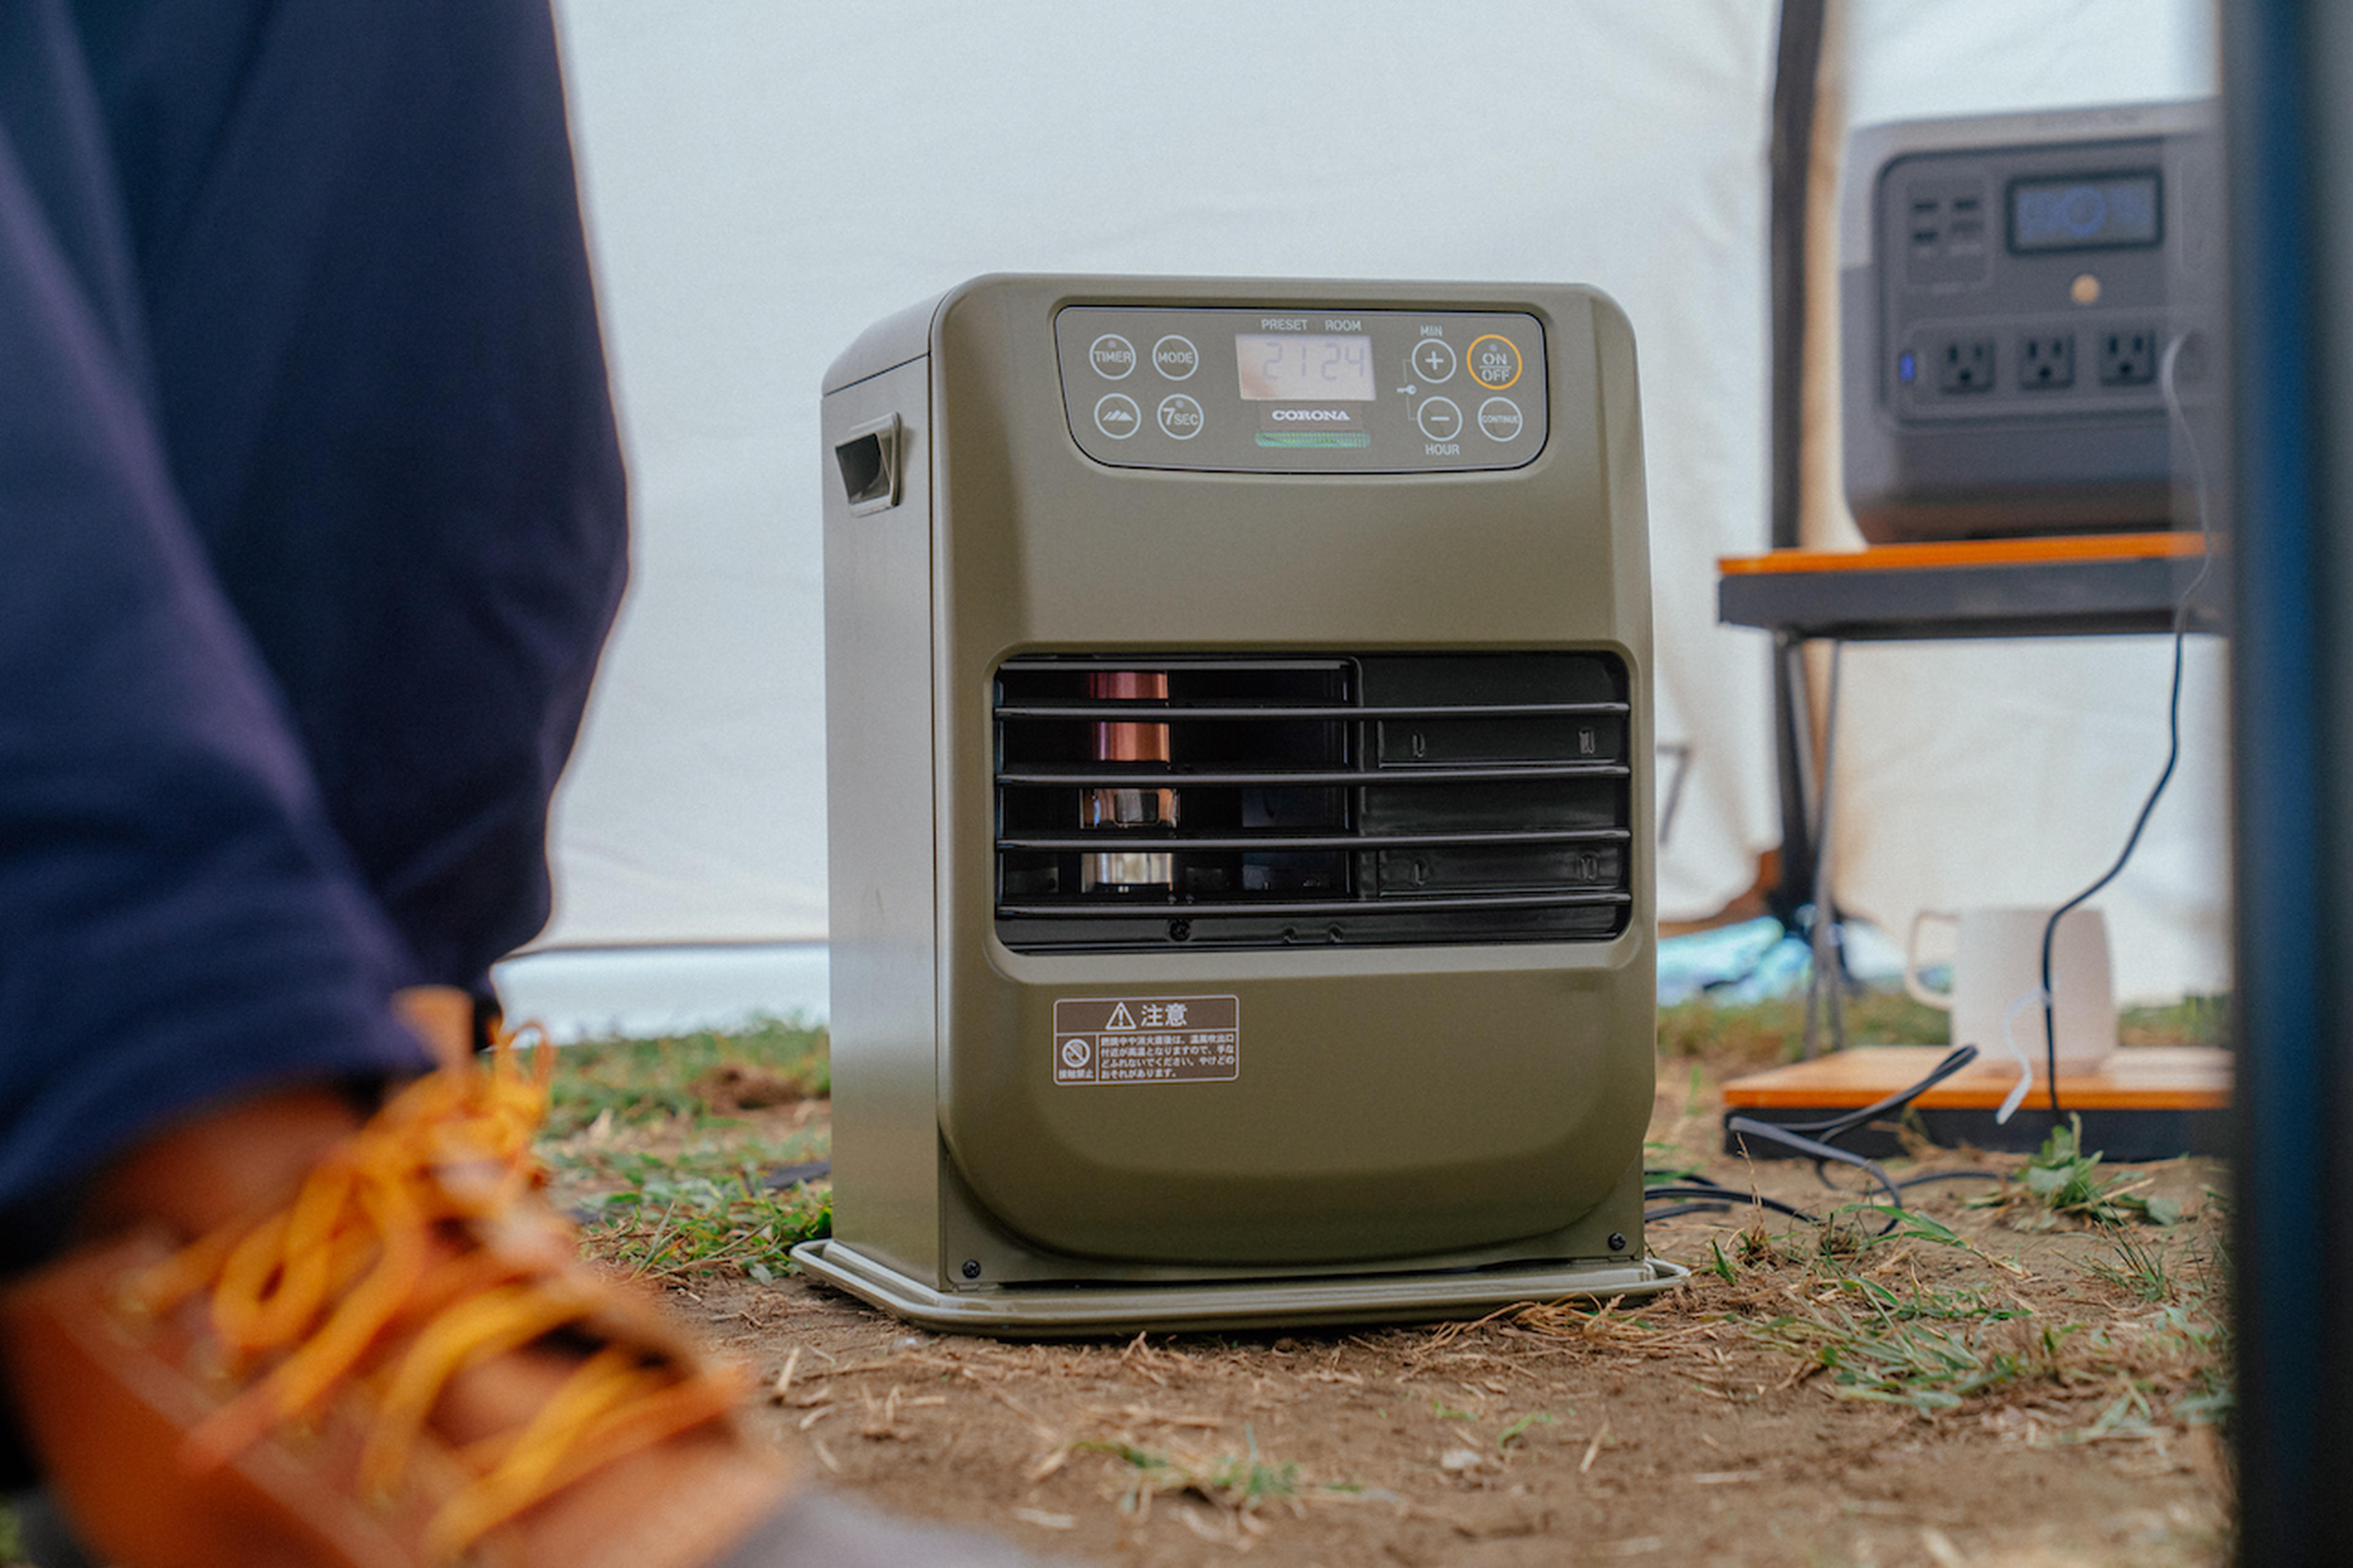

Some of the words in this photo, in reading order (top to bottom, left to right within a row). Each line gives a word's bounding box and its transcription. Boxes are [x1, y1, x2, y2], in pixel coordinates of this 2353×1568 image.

[1261, 318, 1308, 331] PRESET
[1325, 319, 1362, 331] ROOM
[1420, 325, 1442, 336] MIN
[1094, 350, 1132, 363] TIMER
[1158, 351, 1194, 364] MODE
[1262, 341, 1306, 381] 21
[1321, 342, 1365, 381] 24
[1482, 352, 1507, 365] ON
[1482, 369, 1510, 382] OFF
[1271, 409, 1351, 421] CORONA
[1482, 415, 1520, 423] CONTINUE
[1425, 444, 1460, 455] HOUR
[1141, 1002, 1188, 1027] 注意
